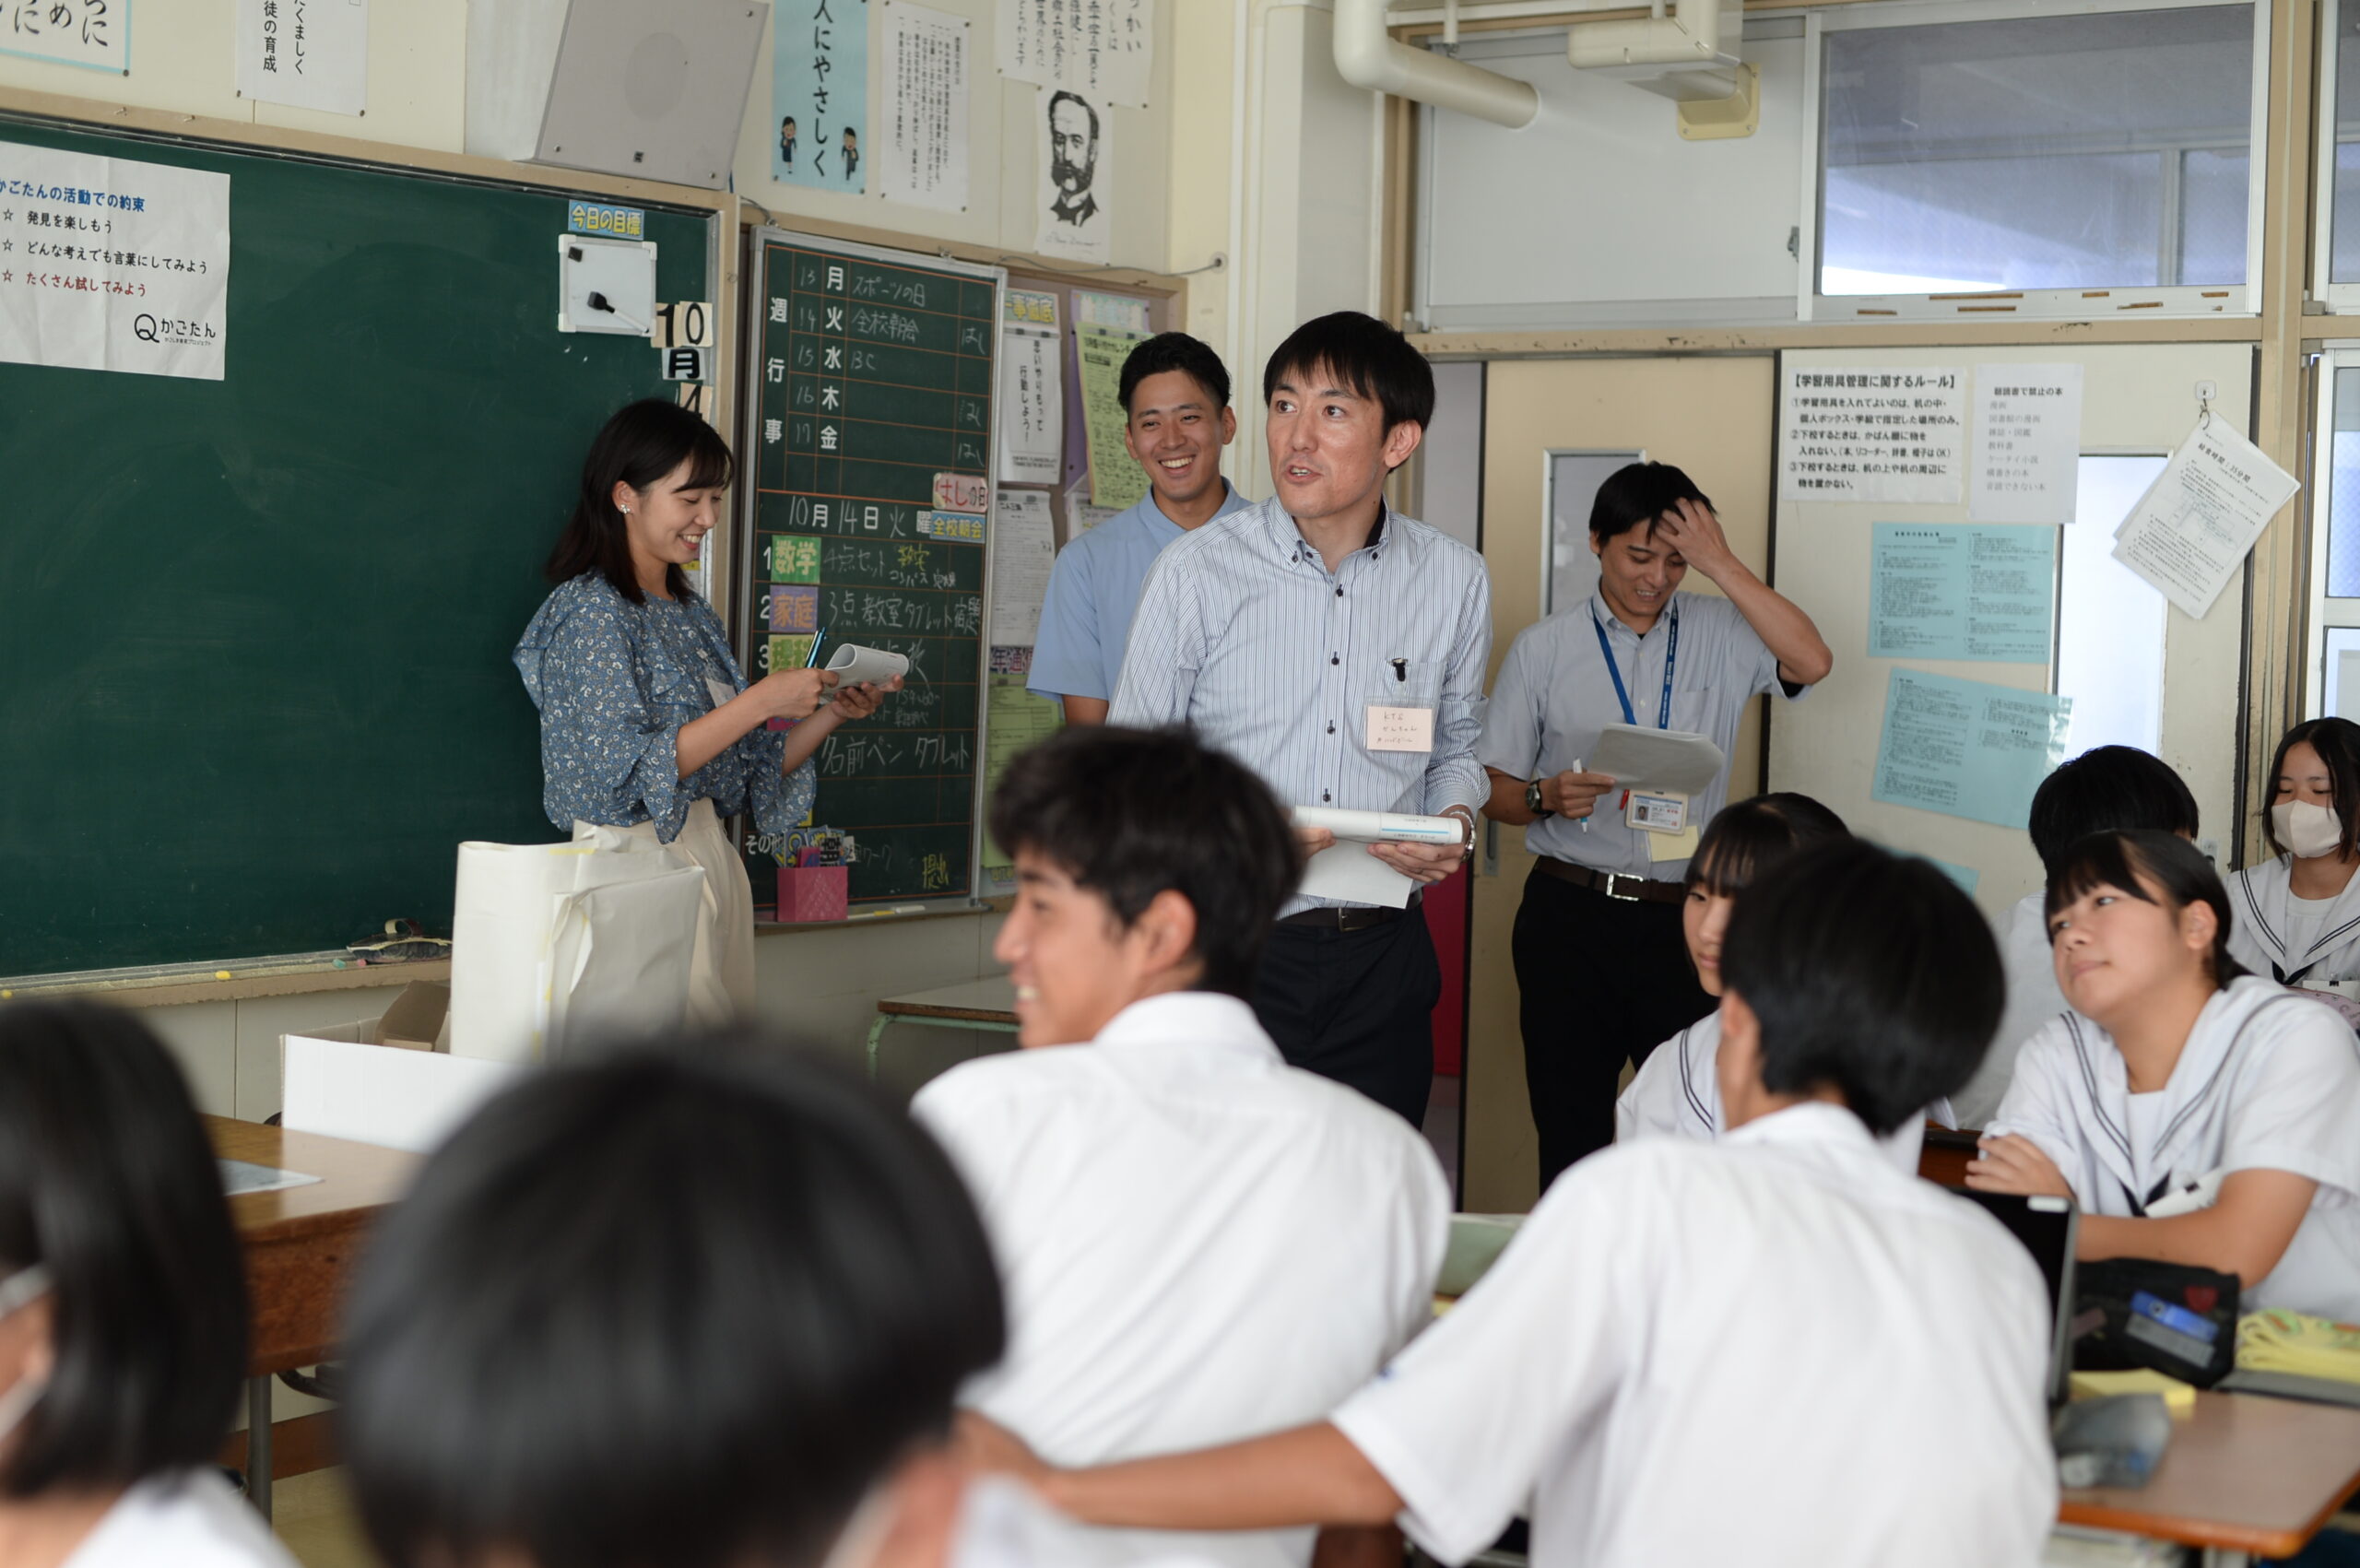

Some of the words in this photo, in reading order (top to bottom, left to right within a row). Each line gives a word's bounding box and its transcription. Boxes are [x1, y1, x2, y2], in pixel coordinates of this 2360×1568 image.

[263, 0, 277, 73] 徒の育成
[813, 0, 833, 177] 人にやさしく
[27, 210, 112, 234] 発見を楽しもう
[572, 206, 642, 236] 今日の目標
[27, 241, 207, 275] どんな考えでも言葉にしてみよう
[26, 271, 147, 297] たくさん試してみよう
[827, 266, 844, 291] 月
[852, 276, 926, 308] スポーツの日
[161, 318, 216, 338] かごたん
[657, 303, 704, 347] 10
[826, 306, 843, 331] 火
[668, 349, 701, 379] 月
[824, 346, 841, 370] 水
[822, 386, 839, 410] 木
[820, 426, 837, 450] 金
[933, 517, 983, 538] 全校朝会
[775, 540, 818, 576] 数学
[773, 594, 815, 630] 家庭
[821, 735, 903, 778] 名前ペン
